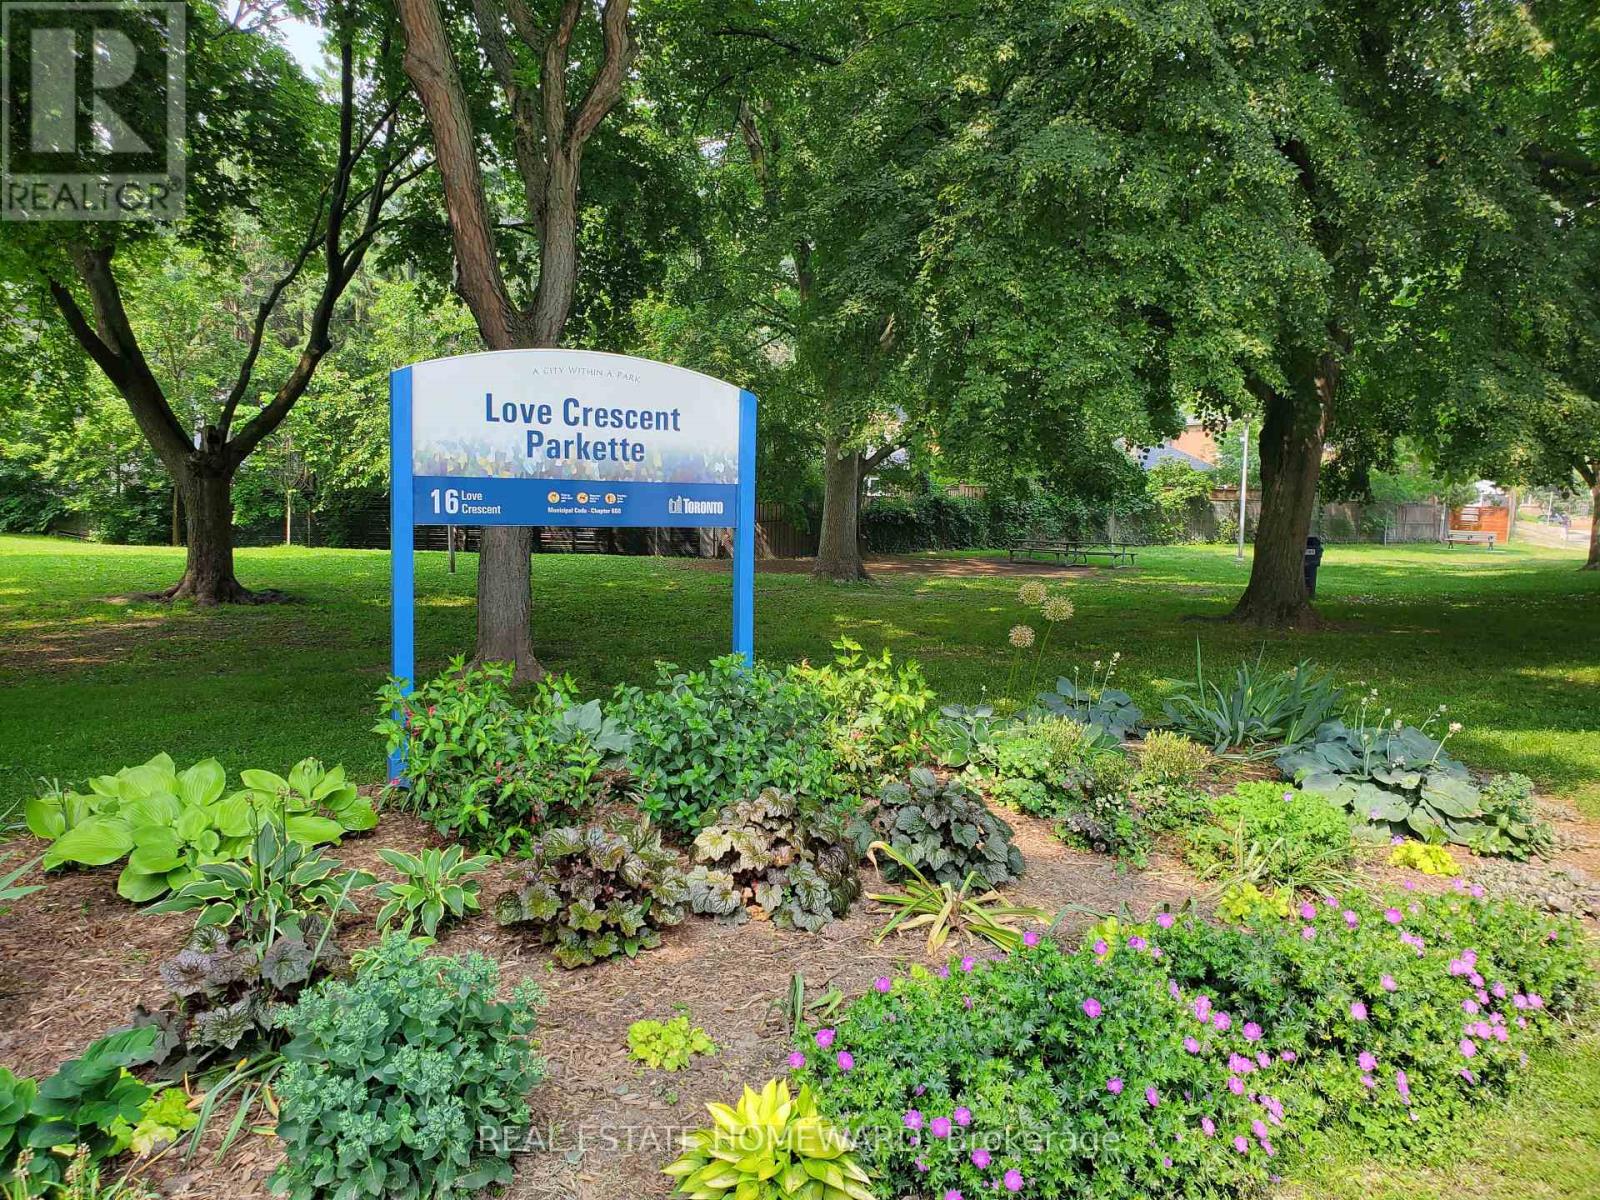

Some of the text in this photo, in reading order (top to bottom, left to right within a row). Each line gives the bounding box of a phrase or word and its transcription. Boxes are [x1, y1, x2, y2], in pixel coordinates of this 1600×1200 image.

[532, 366, 641, 384] A CITY WITHIN A PARK
[485, 393, 681, 432] Love Crescent
[526, 429, 645, 463] Parkette
[430, 488, 459, 514] 16
[461, 490, 483, 501] Love
[461, 503, 501, 515] Crescent
[683, 498, 723, 514] TORONTO
